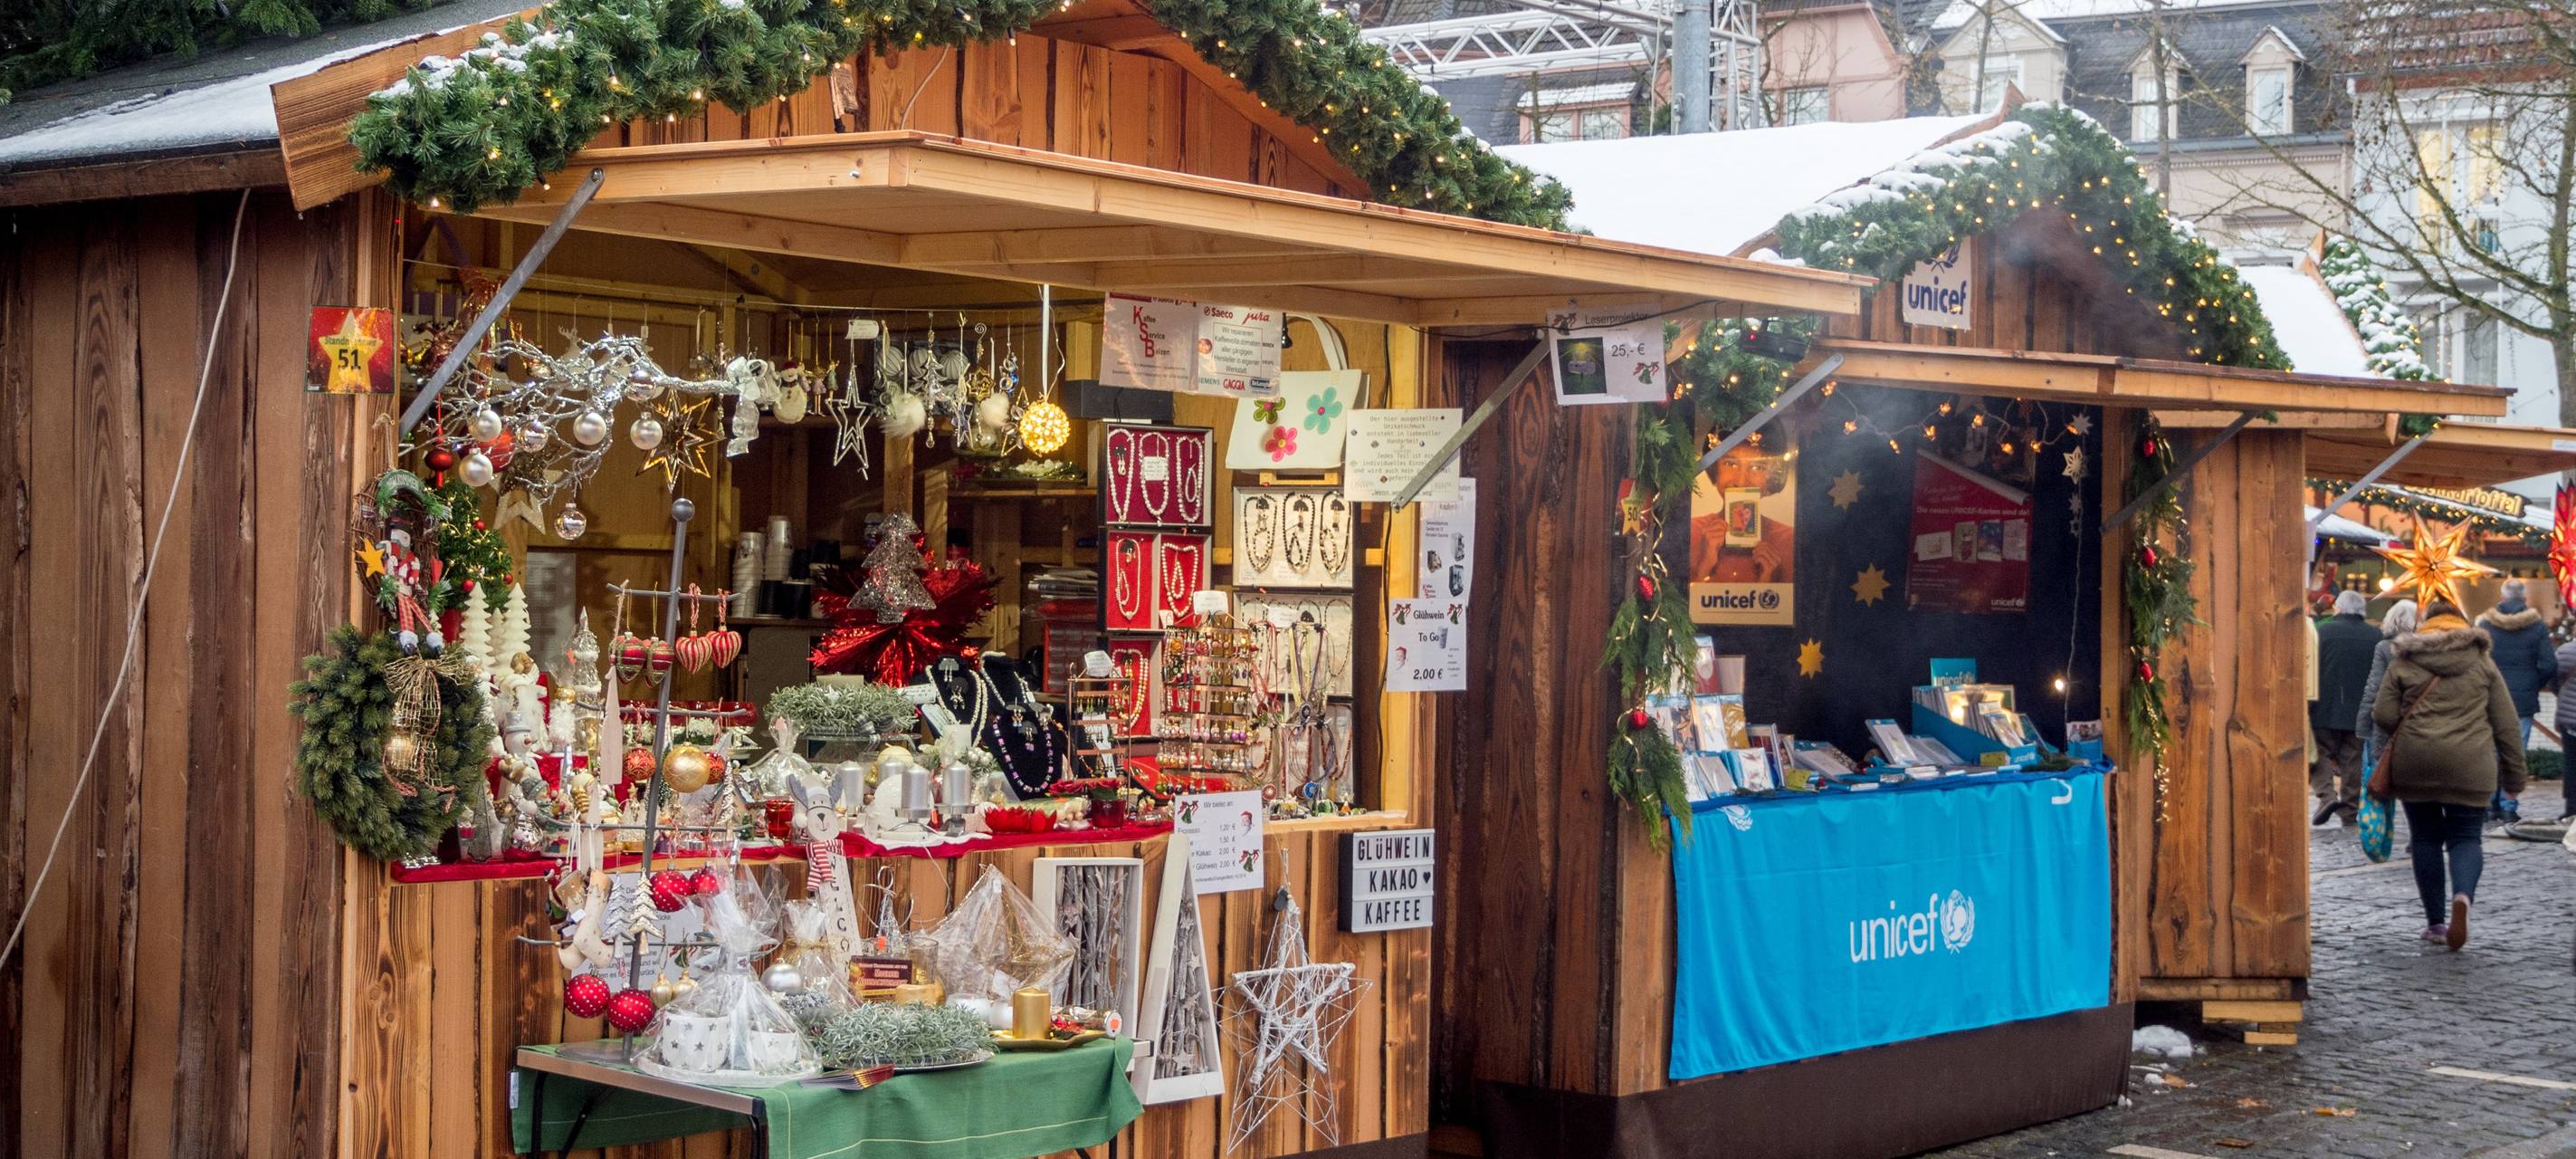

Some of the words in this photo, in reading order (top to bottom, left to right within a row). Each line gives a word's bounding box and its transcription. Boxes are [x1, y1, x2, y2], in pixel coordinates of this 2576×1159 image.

[1908, 275, 1967, 315] unicef
[1133, 305, 1156, 324] Kaffee
[1211, 307, 1234, 319] Saeco
[1242, 311, 1270, 325] jura
[1140, 322, 1166, 341] Service
[338, 349, 361, 370] 51
[1611, 344, 1634, 358] 25,-
[1637, 342, 1646, 356] €
[1198, 377, 1220, 386] IEMENS
[1223, 378, 1245, 391] GAGGIA
[1627, 506, 1637, 522] 50
[1701, 589, 1756, 608] unicef
[1991, 597, 2015, 607] unicef
[1413, 609, 1445, 619] Glühwein
[1417, 632, 1427, 641] To
[1429, 632, 1439, 641] Go
[1413, 668, 1436, 680] 2,00
[1437, 668, 1444, 679] €
[1358, 836, 1430, 860] GLÜHWEIN
[1369, 867, 1417, 893] KAKAO
[1365, 899, 1420, 924] KAFFEE
[1850, 893, 1939, 963] unicef
